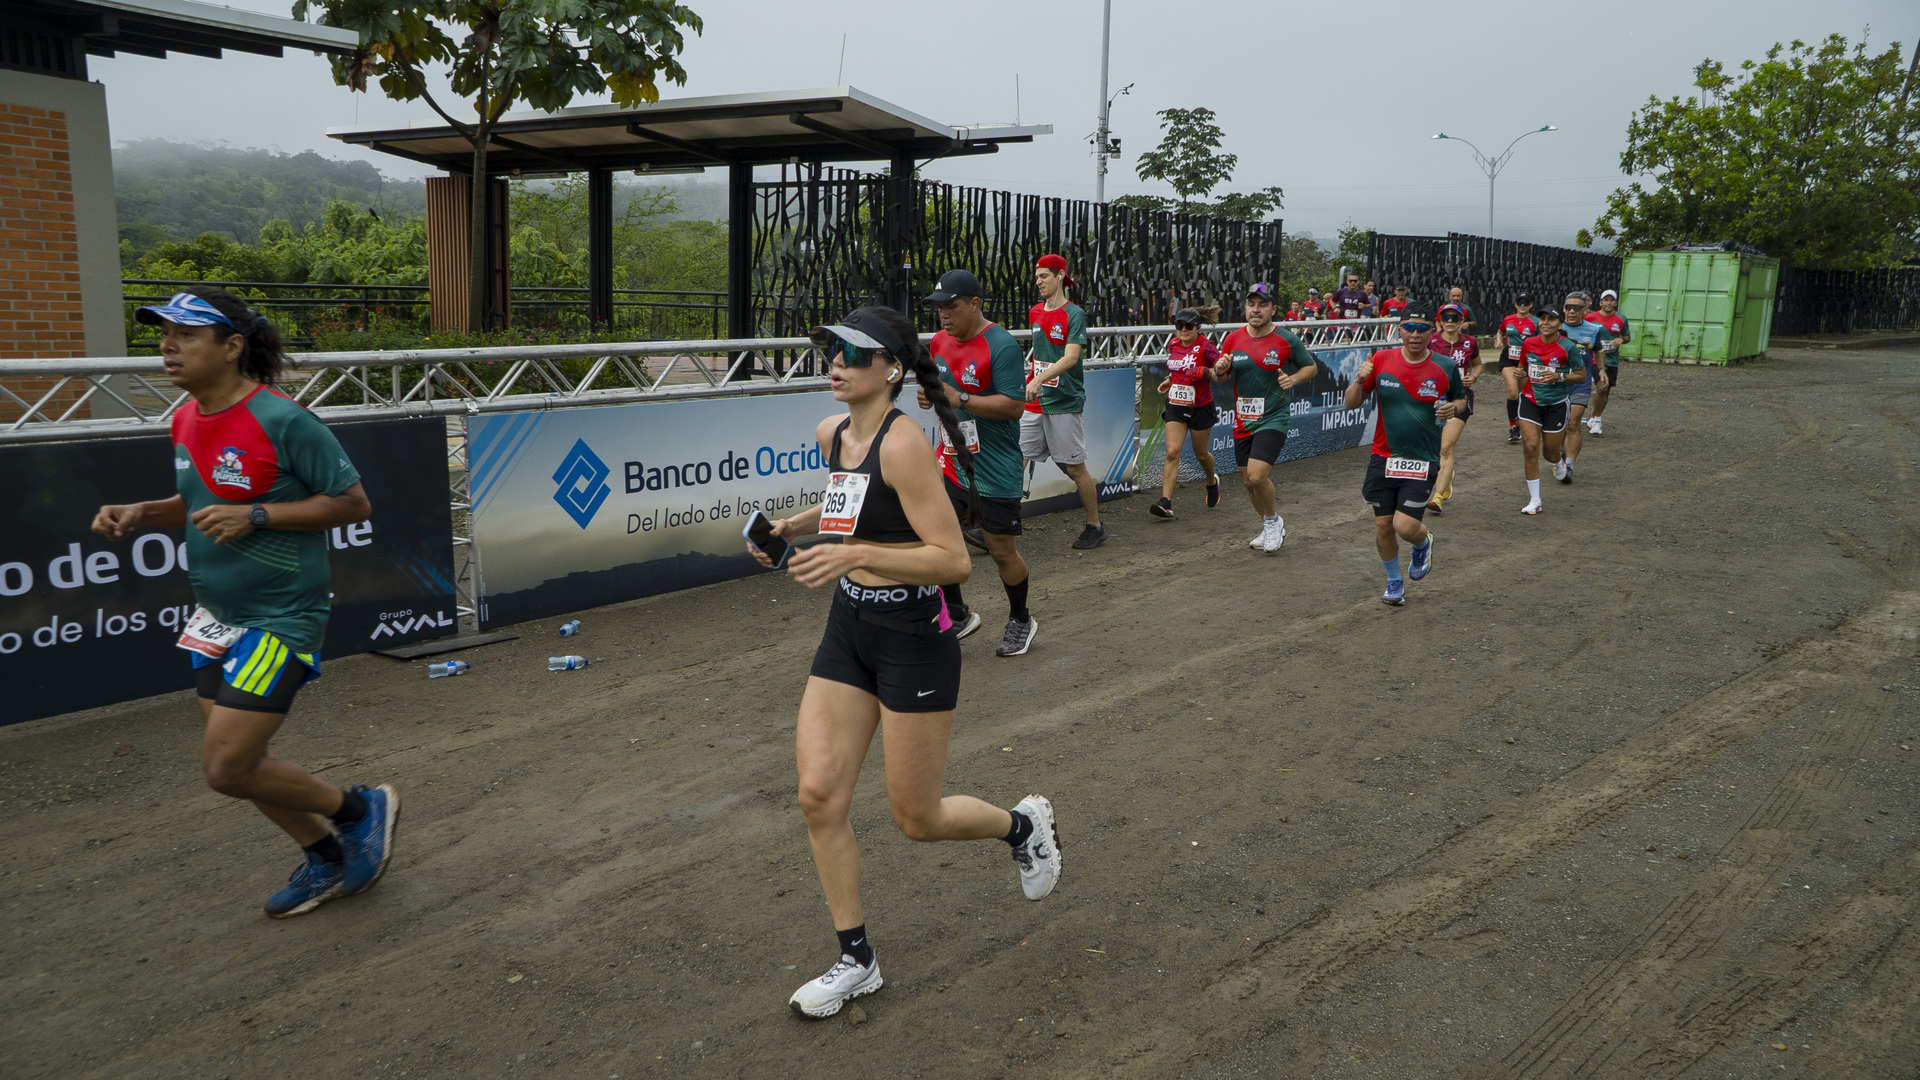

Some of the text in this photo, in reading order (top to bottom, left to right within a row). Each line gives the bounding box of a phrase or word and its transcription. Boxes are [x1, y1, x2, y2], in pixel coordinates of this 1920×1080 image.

[1174, 391, 1188, 400] 153
[1322, 391, 1334, 409] TU
[1241, 405, 1256, 414] 474
[1322, 407, 1368, 431] IMPACTA.
[1212, 436, 1225, 451] Del
[624, 460, 712, 494] Banco
[718, 450, 750, 482] de
[1394, 460, 1421, 471] 1820
[1101, 482, 1130, 496] AVAL
[825, 492, 846, 514] 269
[627, 508, 658, 534] Del
[664, 503, 705, 529] lado
[710, 499, 731, 521] de
[736, 496, 760, 517] los
[765, 494, 795, 516] que
[48, 542, 120, 589] de
[861, 588, 909, 603] PRO
[379, 608, 413, 621] Grupo
[33, 614, 83, 648] de
[96, 608, 147, 638] los
[370, 610, 454, 641] AVAL
